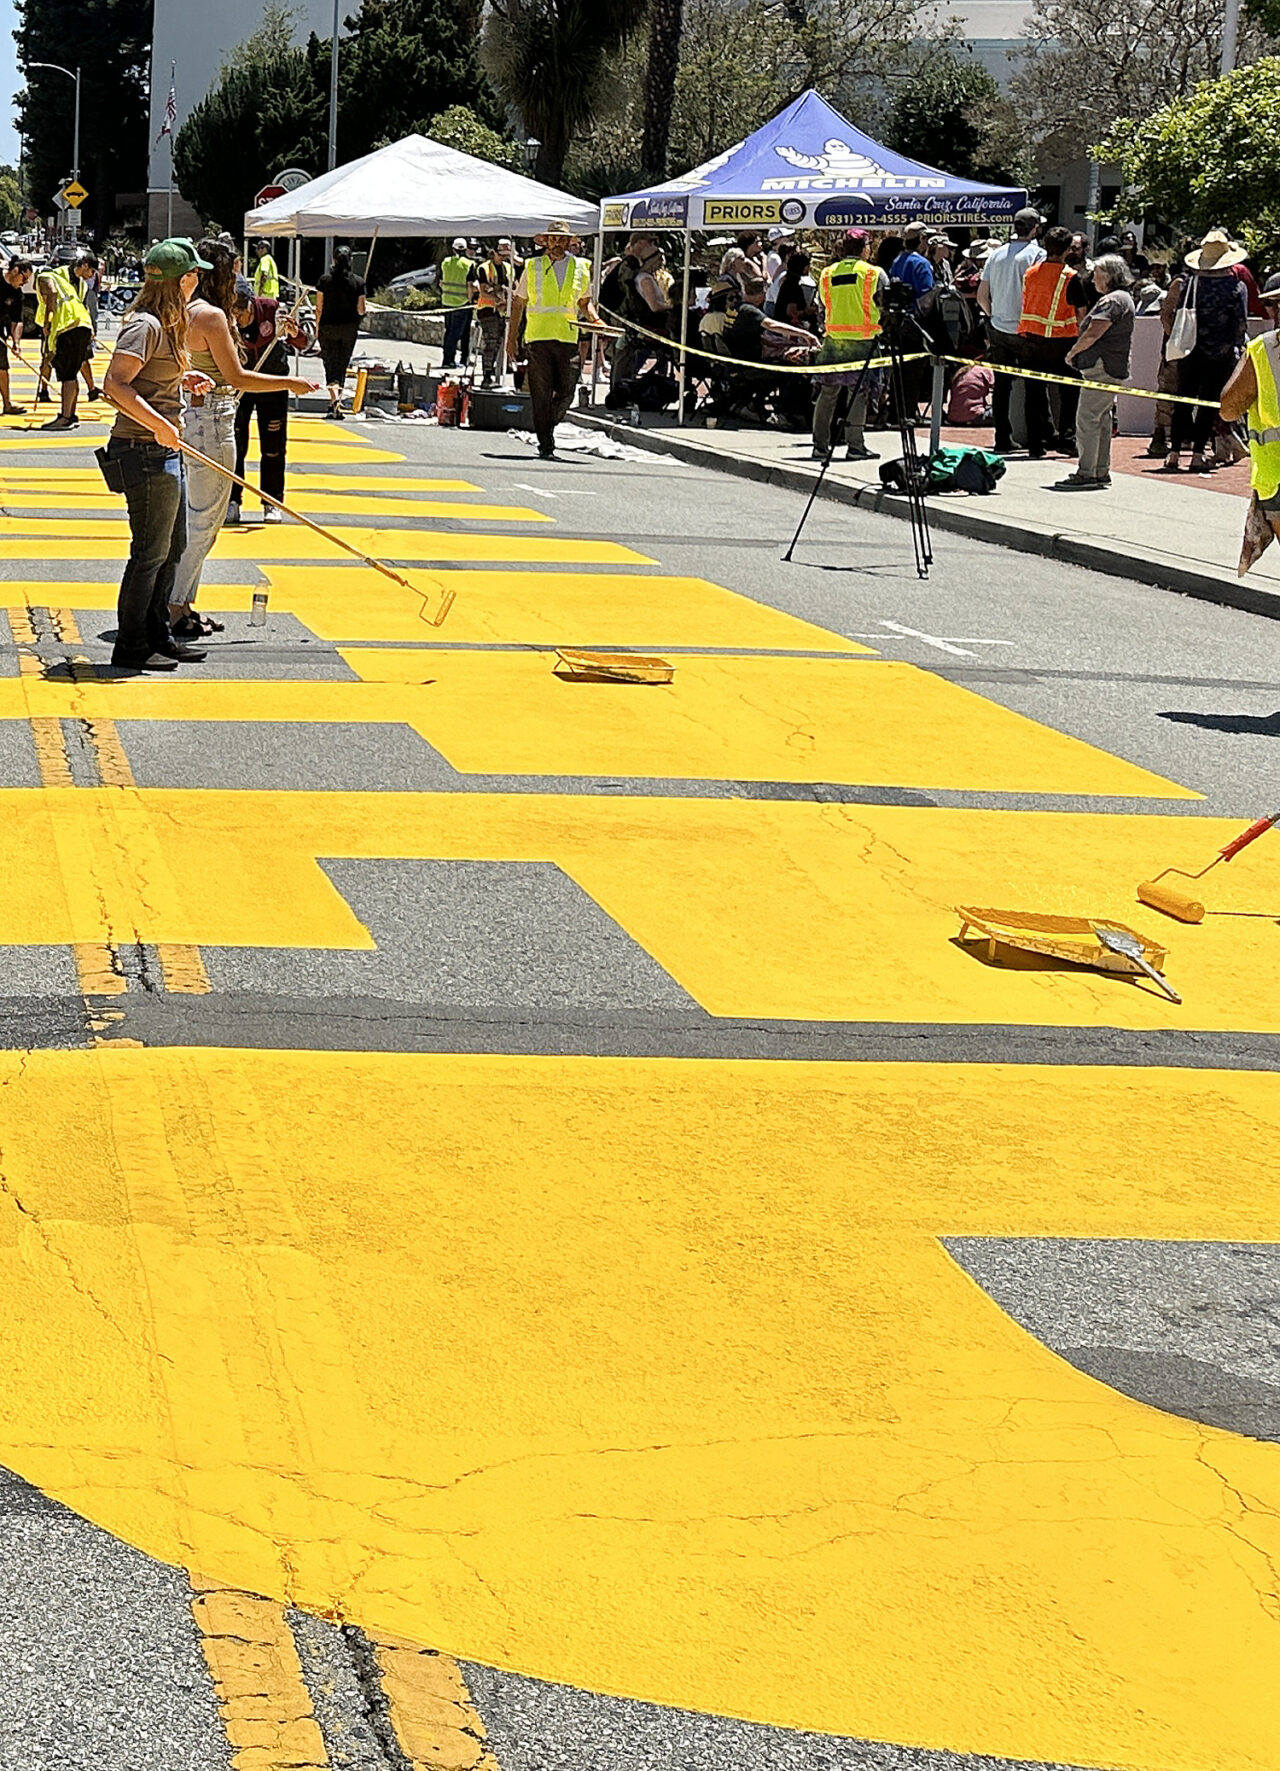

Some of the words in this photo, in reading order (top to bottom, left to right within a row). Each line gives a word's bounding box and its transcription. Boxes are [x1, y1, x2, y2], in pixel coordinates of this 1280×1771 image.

[761, 179, 945, 190] MICHELIN
[885, 196, 922, 211] Santa
[924, 196, 953, 212] Cruz,
[956, 195, 1013, 212] California
[710, 205, 776, 219] PRIORS
[825, 214, 854, 224] (831)
[856, 214, 907, 224] 212-4555
[916, 212, 1013, 223] PRIORSTIRES.com
